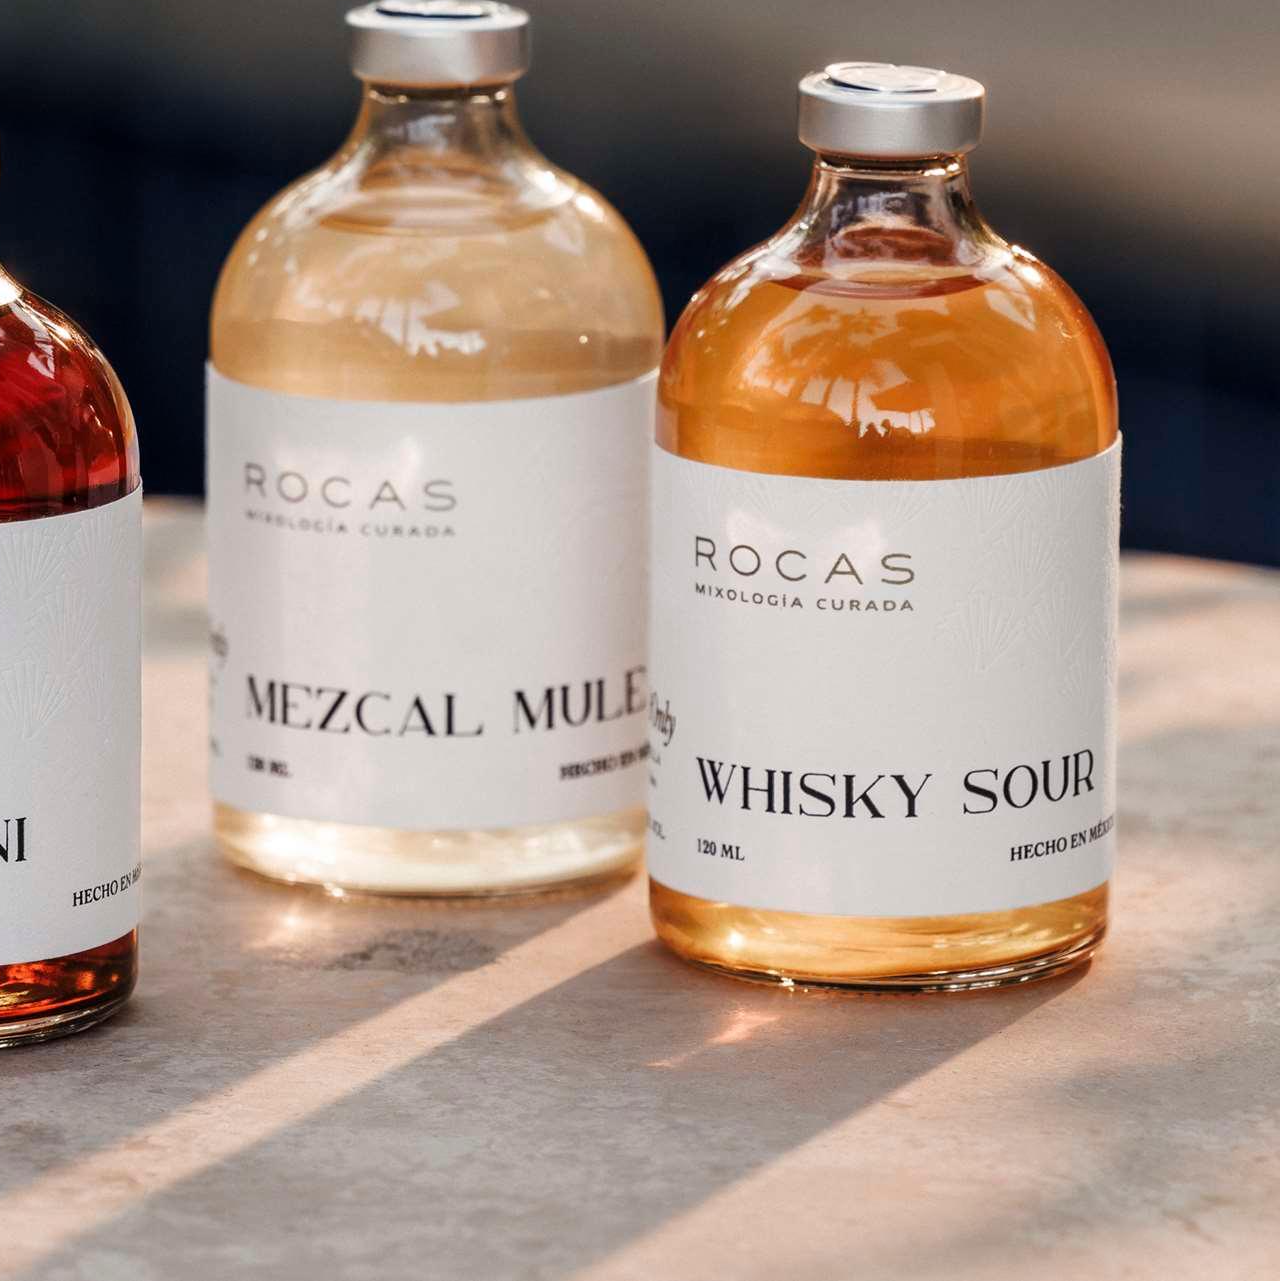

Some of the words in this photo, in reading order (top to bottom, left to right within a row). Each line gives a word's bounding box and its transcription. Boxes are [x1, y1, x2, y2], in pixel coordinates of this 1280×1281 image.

[244, 462, 457, 512] ROCAS
[360, 524, 456, 538] CURADA
[695, 536, 915, 585] ROCAS
[695, 583, 803, 609] MIXOLOGÍA
[817, 598, 914, 612] CURADA
[246, 674, 484, 737] MEZCAL
[513, 665, 647, 735] MULE
[696, 756, 932, 818] WHISKY
[962, 749, 1095, 815] SOUR
[697, 838, 716, 856] 120
[721, 844, 745, 861] ML
[1010, 837, 1068, 861] HECHO
[1070, 830, 1088, 850] EN
[72, 880, 119, 907] HECHO
[120, 872, 132, 892] EN
